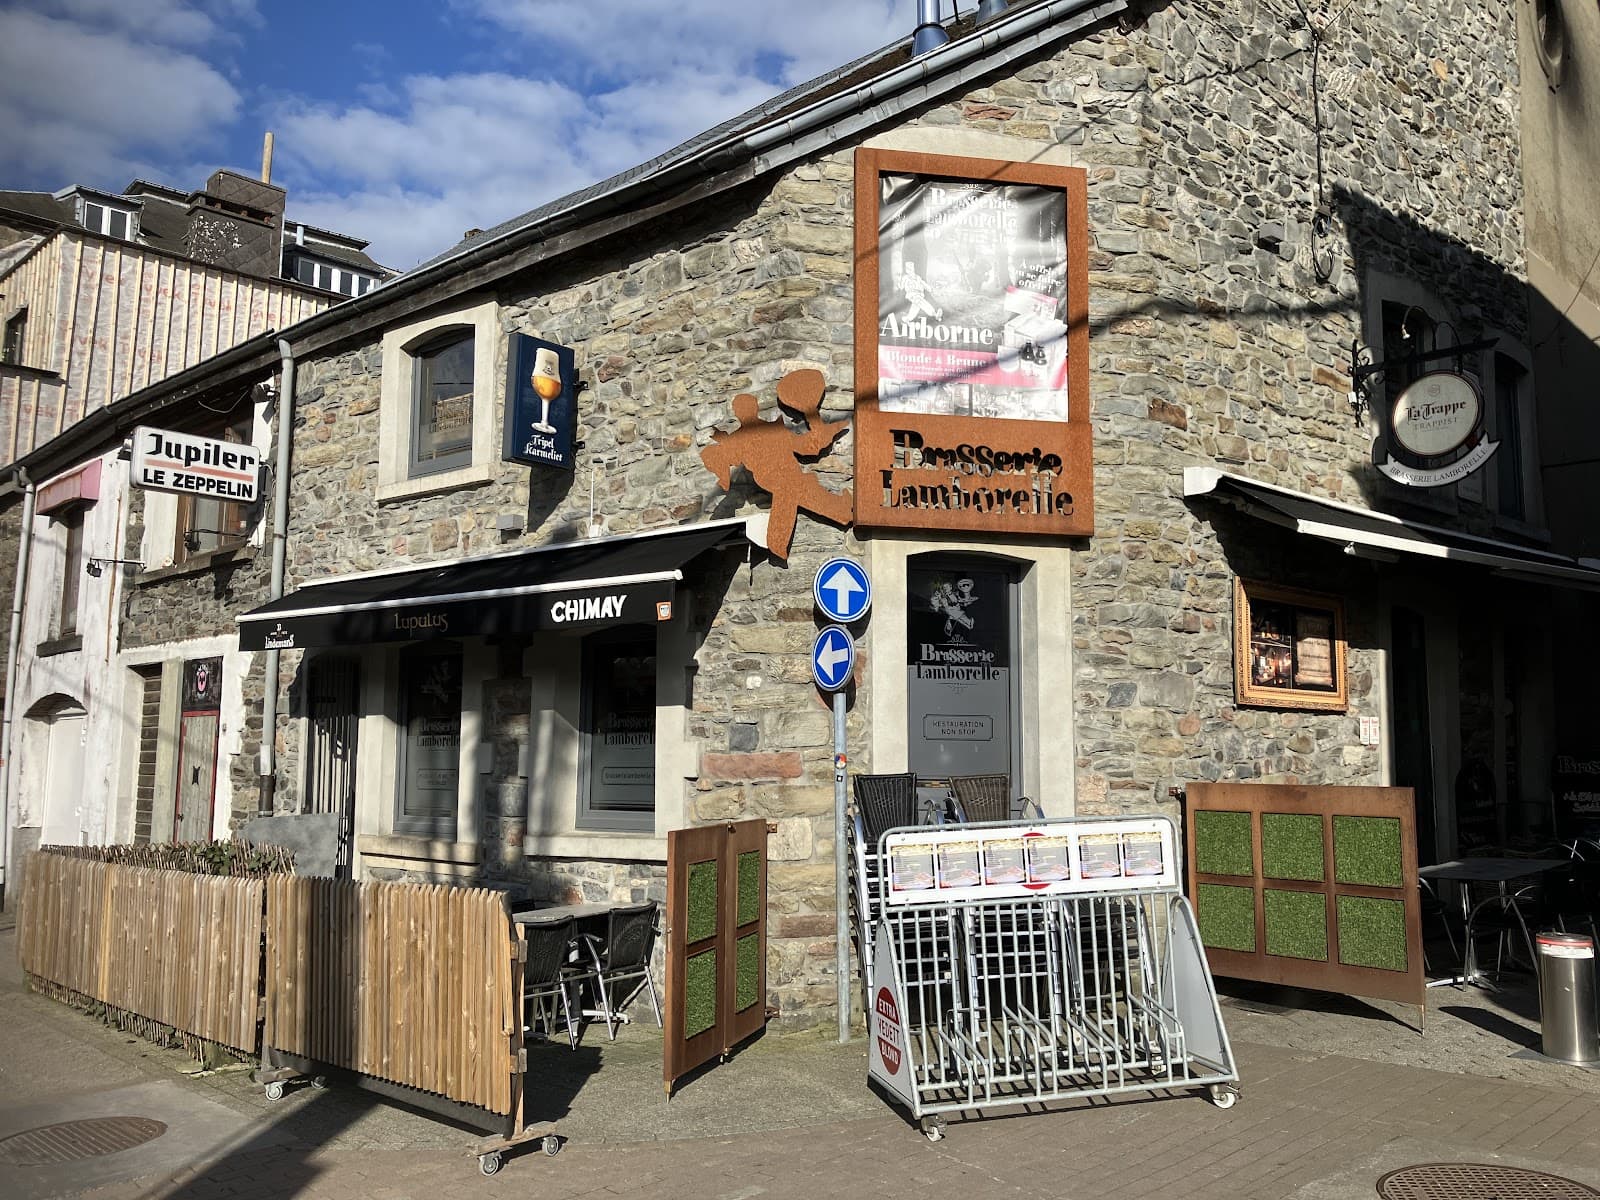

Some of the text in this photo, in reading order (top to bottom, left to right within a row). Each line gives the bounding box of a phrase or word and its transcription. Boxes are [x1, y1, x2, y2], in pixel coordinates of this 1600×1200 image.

[880, 312, 994, 345] Airborne
[1405, 400, 1467, 422] La Trappe
[1414, 417, 1457, 431] TRAPPIST
[145, 433, 255, 471] Jupiler
[530, 434, 555, 449] Tripel
[889, 429, 1064, 478] Brasserie
[1389, 447, 1488, 483] BRASSERIE LAMBORELLE
[143, 468, 253, 499] LE ZEPPELIN
[879, 469, 1074, 517] Lamborelle
[550, 594, 628, 623] CHIMAY
[919, 643, 995, 664] Brasserie
[915, 661, 1001, 681] Lamborelle
[933, 720, 984, 728] RESTAURATION
[958, 728, 976, 736] STOP
[878, 998, 897, 1020] EXTRA
[877, 1017, 900, 1046] VEDETT
[881, 1042, 899, 1065] BLOND
